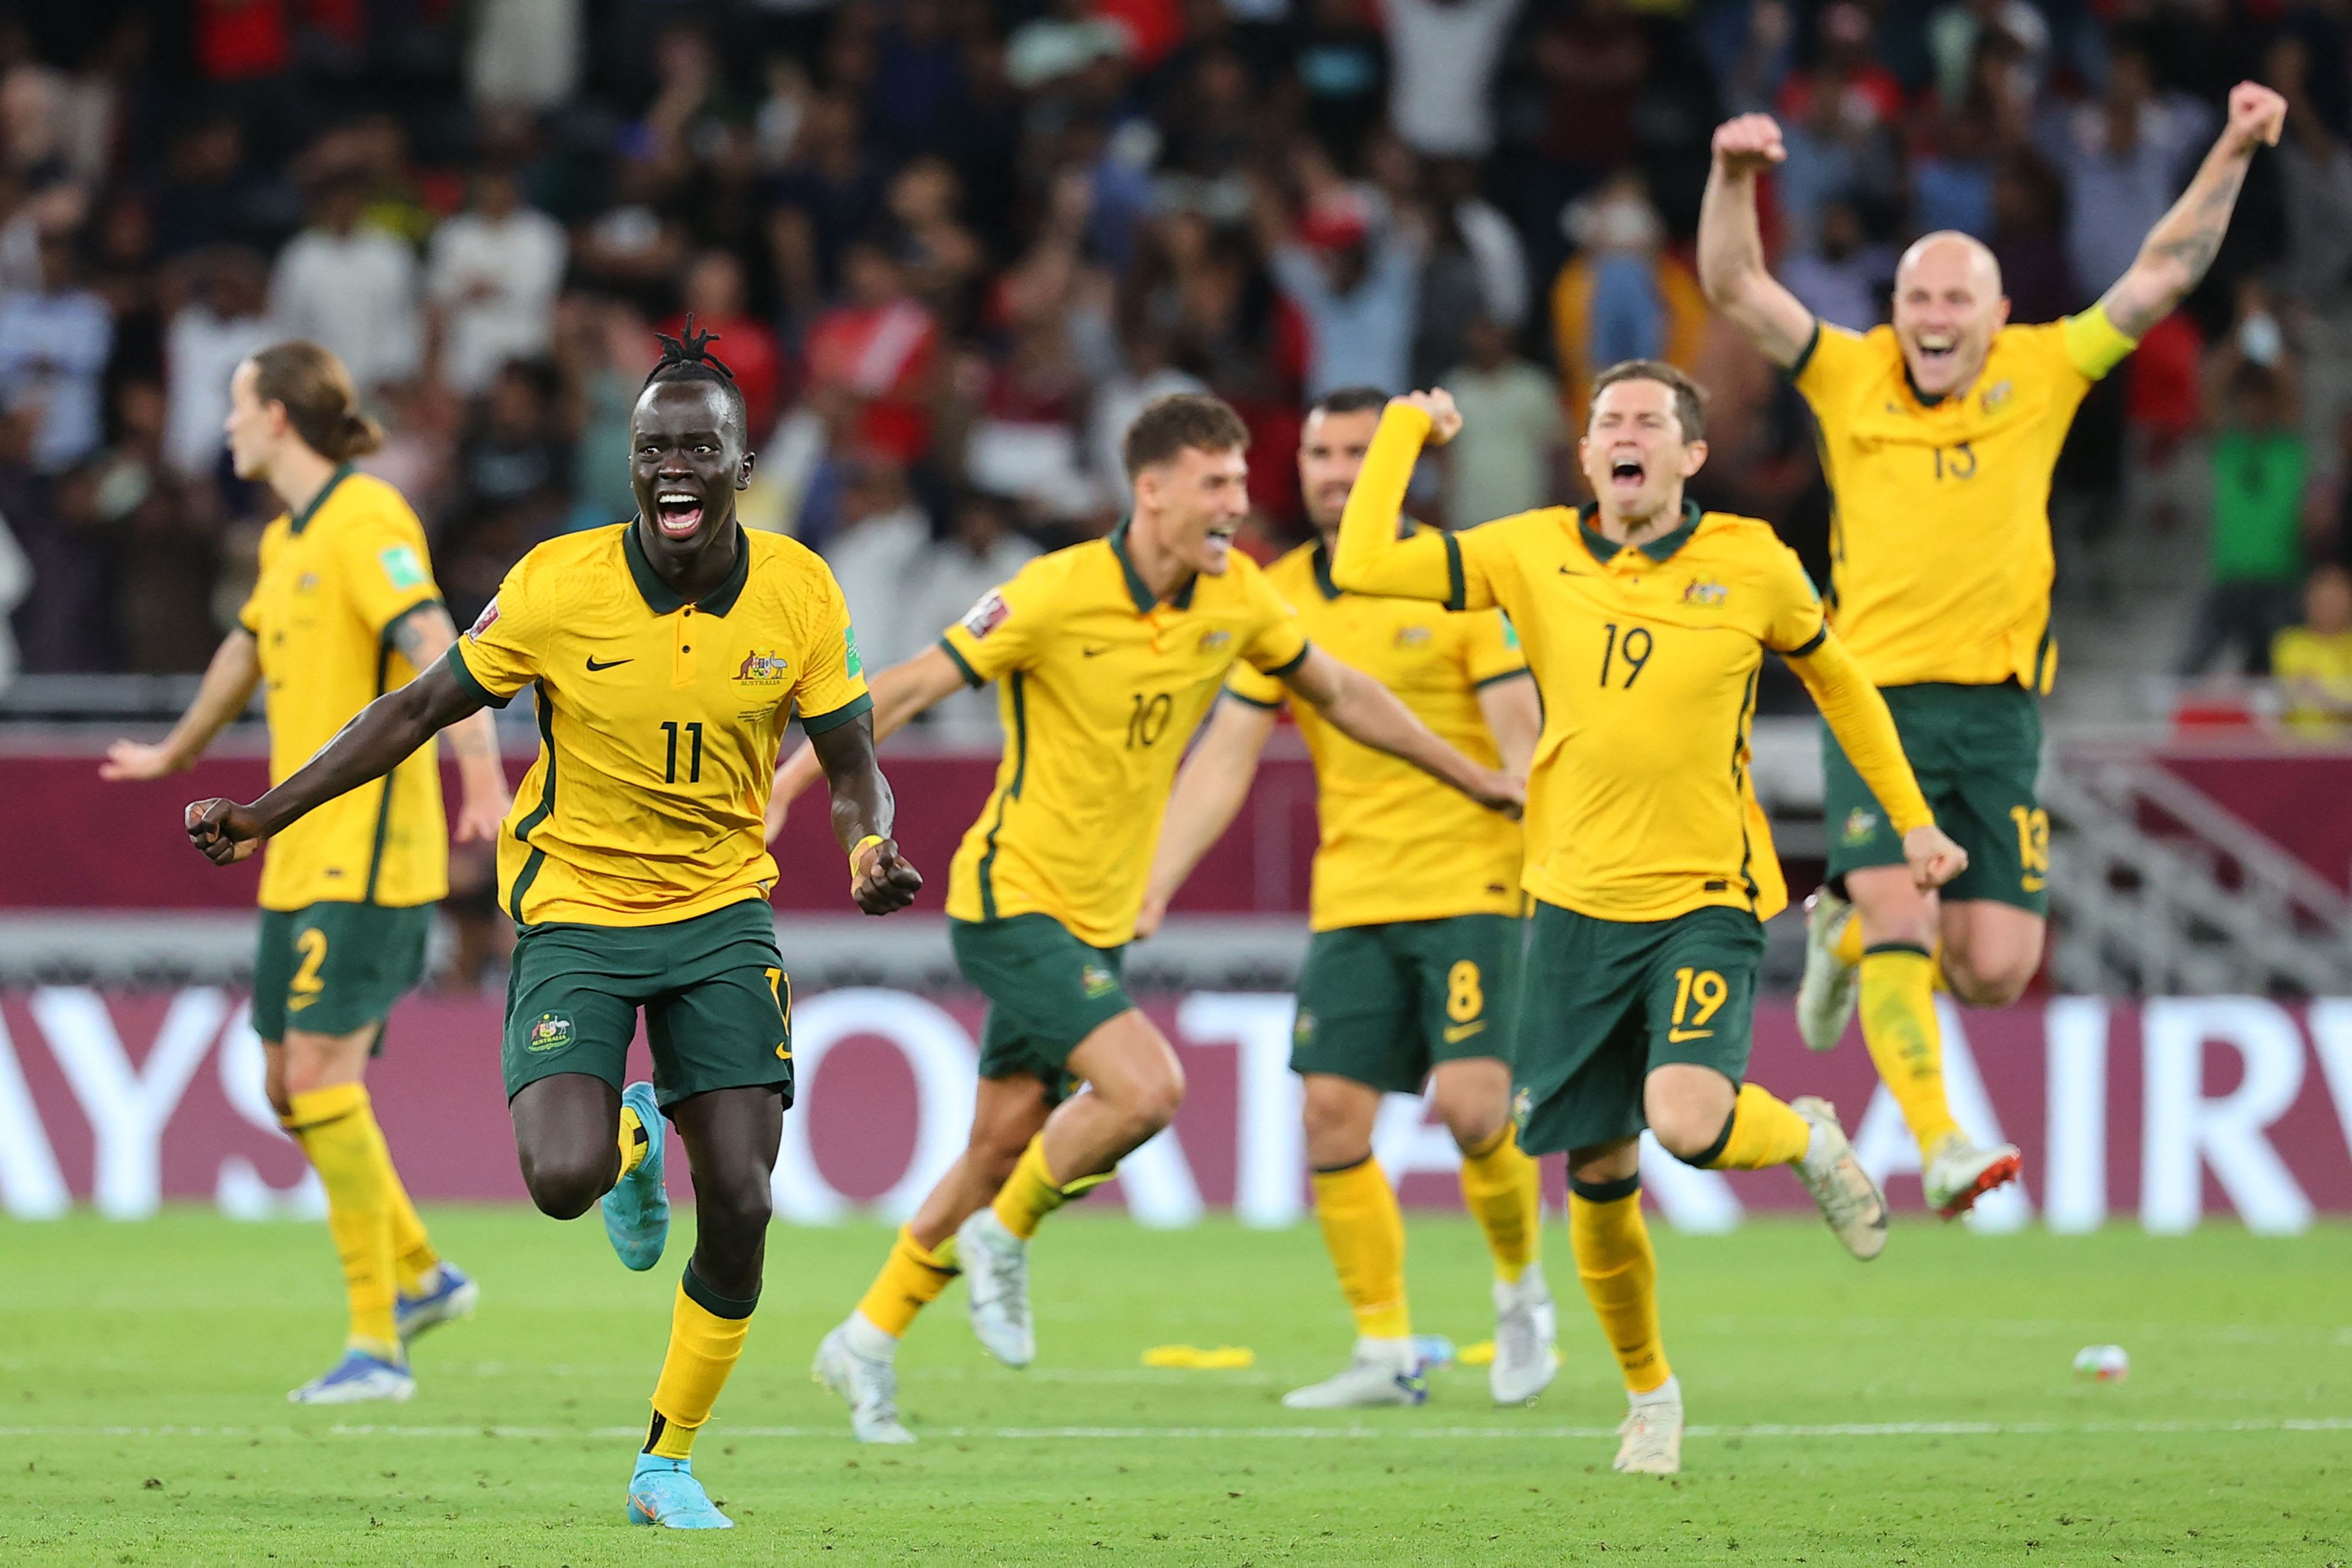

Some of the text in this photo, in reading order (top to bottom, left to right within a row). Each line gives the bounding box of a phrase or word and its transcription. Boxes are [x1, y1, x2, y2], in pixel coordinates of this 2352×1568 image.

[1934, 442, 1976, 479] 13
[1600, 624, 1653, 690] 19
[660, 721, 702, 784] 11
[1125, 693, 1171, 751] 10
[290, 928, 328, 993] 2
[1446, 959, 1484, 1024] 8
[1671, 967, 1728, 1025] 19
[532, 1035, 566, 1046] AUSTRALIA
[1849, 994, 2352, 1236] AIR
